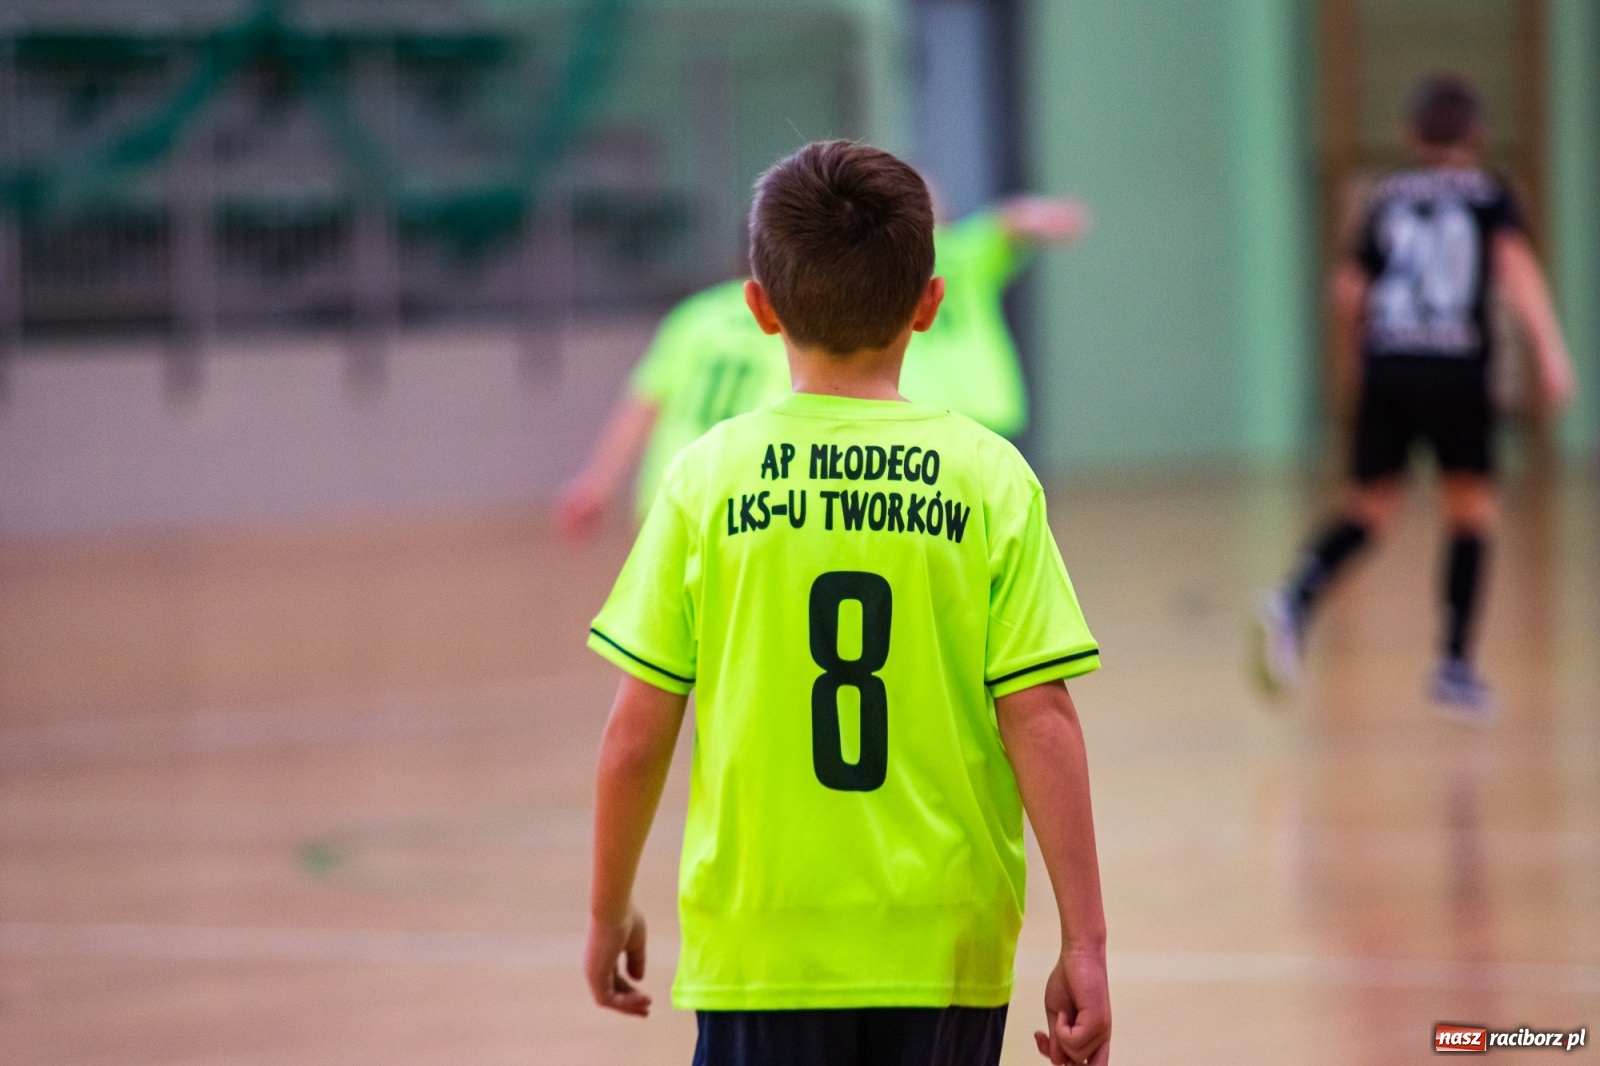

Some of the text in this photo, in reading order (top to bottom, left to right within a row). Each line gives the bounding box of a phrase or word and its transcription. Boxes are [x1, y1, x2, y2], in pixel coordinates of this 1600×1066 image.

[761, 443, 940, 485] AP MŁODEGO
[727, 489, 971, 544] LKS-U TWORKÓW
[808, 570, 893, 793] 8
